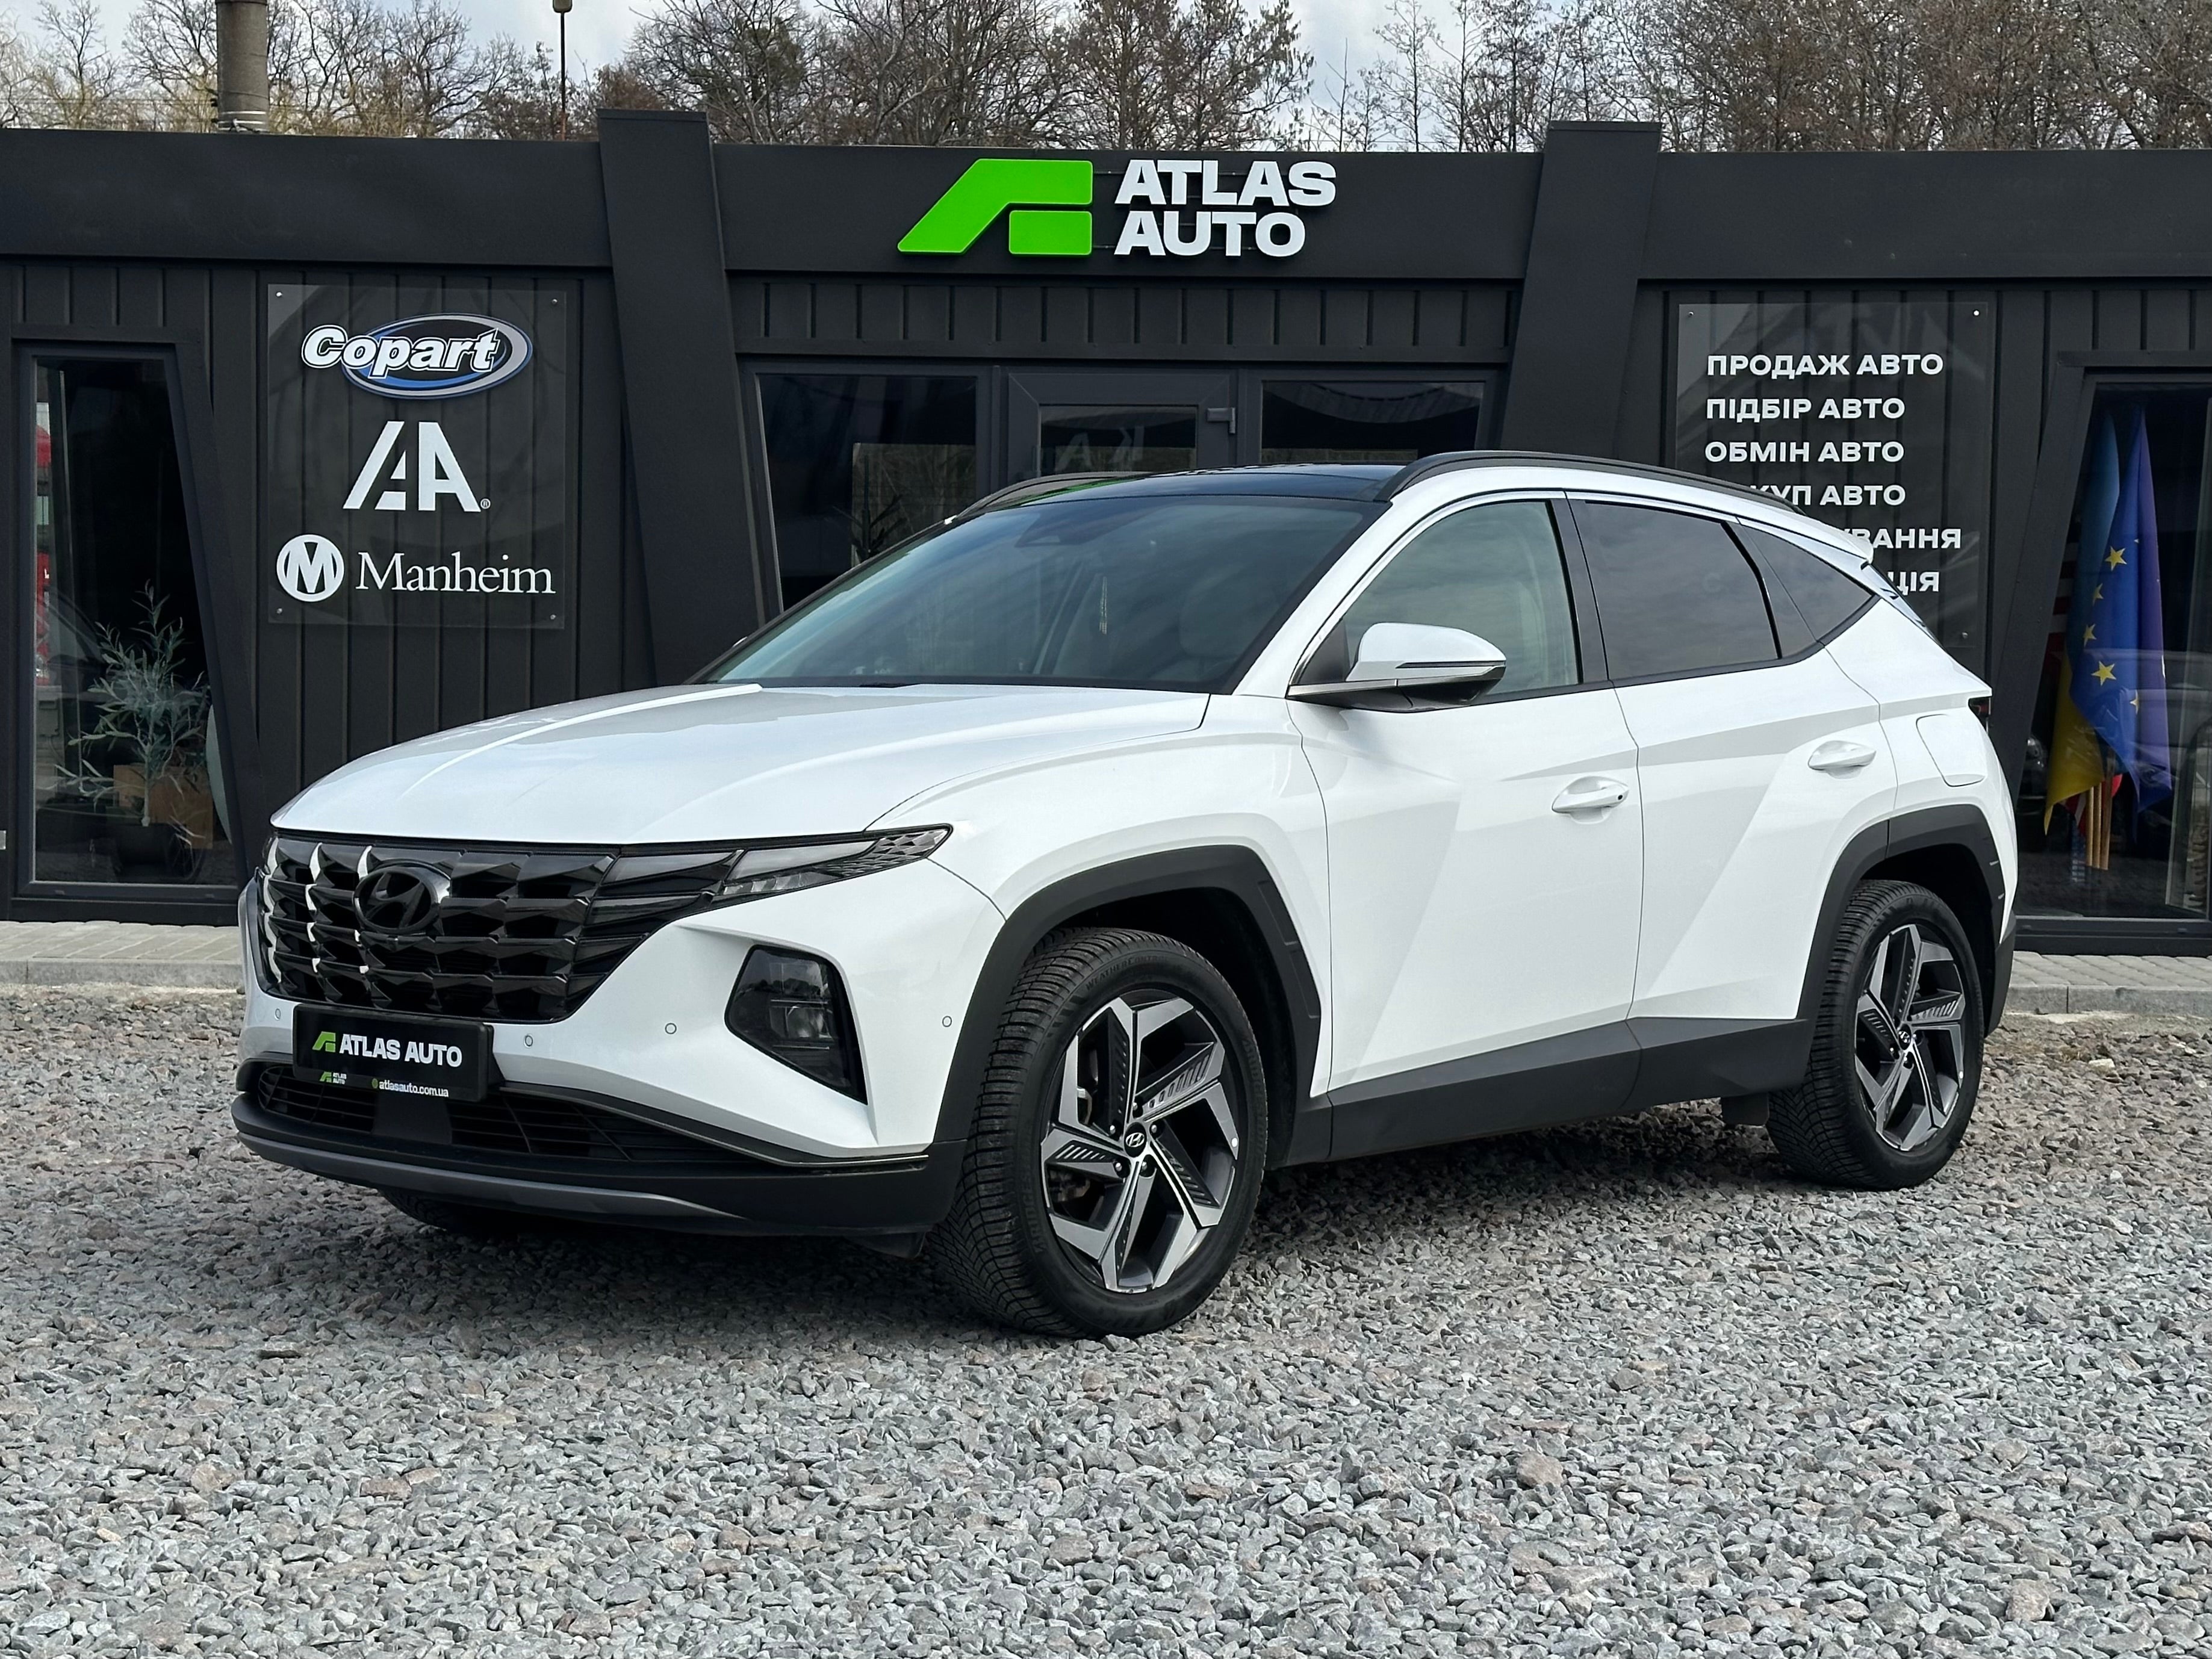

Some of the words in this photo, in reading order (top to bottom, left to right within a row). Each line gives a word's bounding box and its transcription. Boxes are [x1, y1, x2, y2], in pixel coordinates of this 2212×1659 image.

[1114, 160, 1337, 206] ATLAS
[1114, 211, 1305, 257] AUTO
[302, 324, 500, 379] Copart
[1707, 355, 1850, 380] ПРОДАЖ
[1856, 354, 1943, 375] АВТО
[1706, 398, 1812, 423] ПІДБІР
[1818, 398, 1905, 419] АВТО
[1705, 441, 1810, 462] ОБМІН
[1818, 441, 1904, 462] АВТО
[1819, 485, 1906, 506] АВТО
[355, 551, 556, 594] Manheim
[339, 1034, 400, 1061] ATLAS
[404, 1041, 462, 1067] AUTO
[378, 1079, 449, 1097] atlasauto.com.ua
